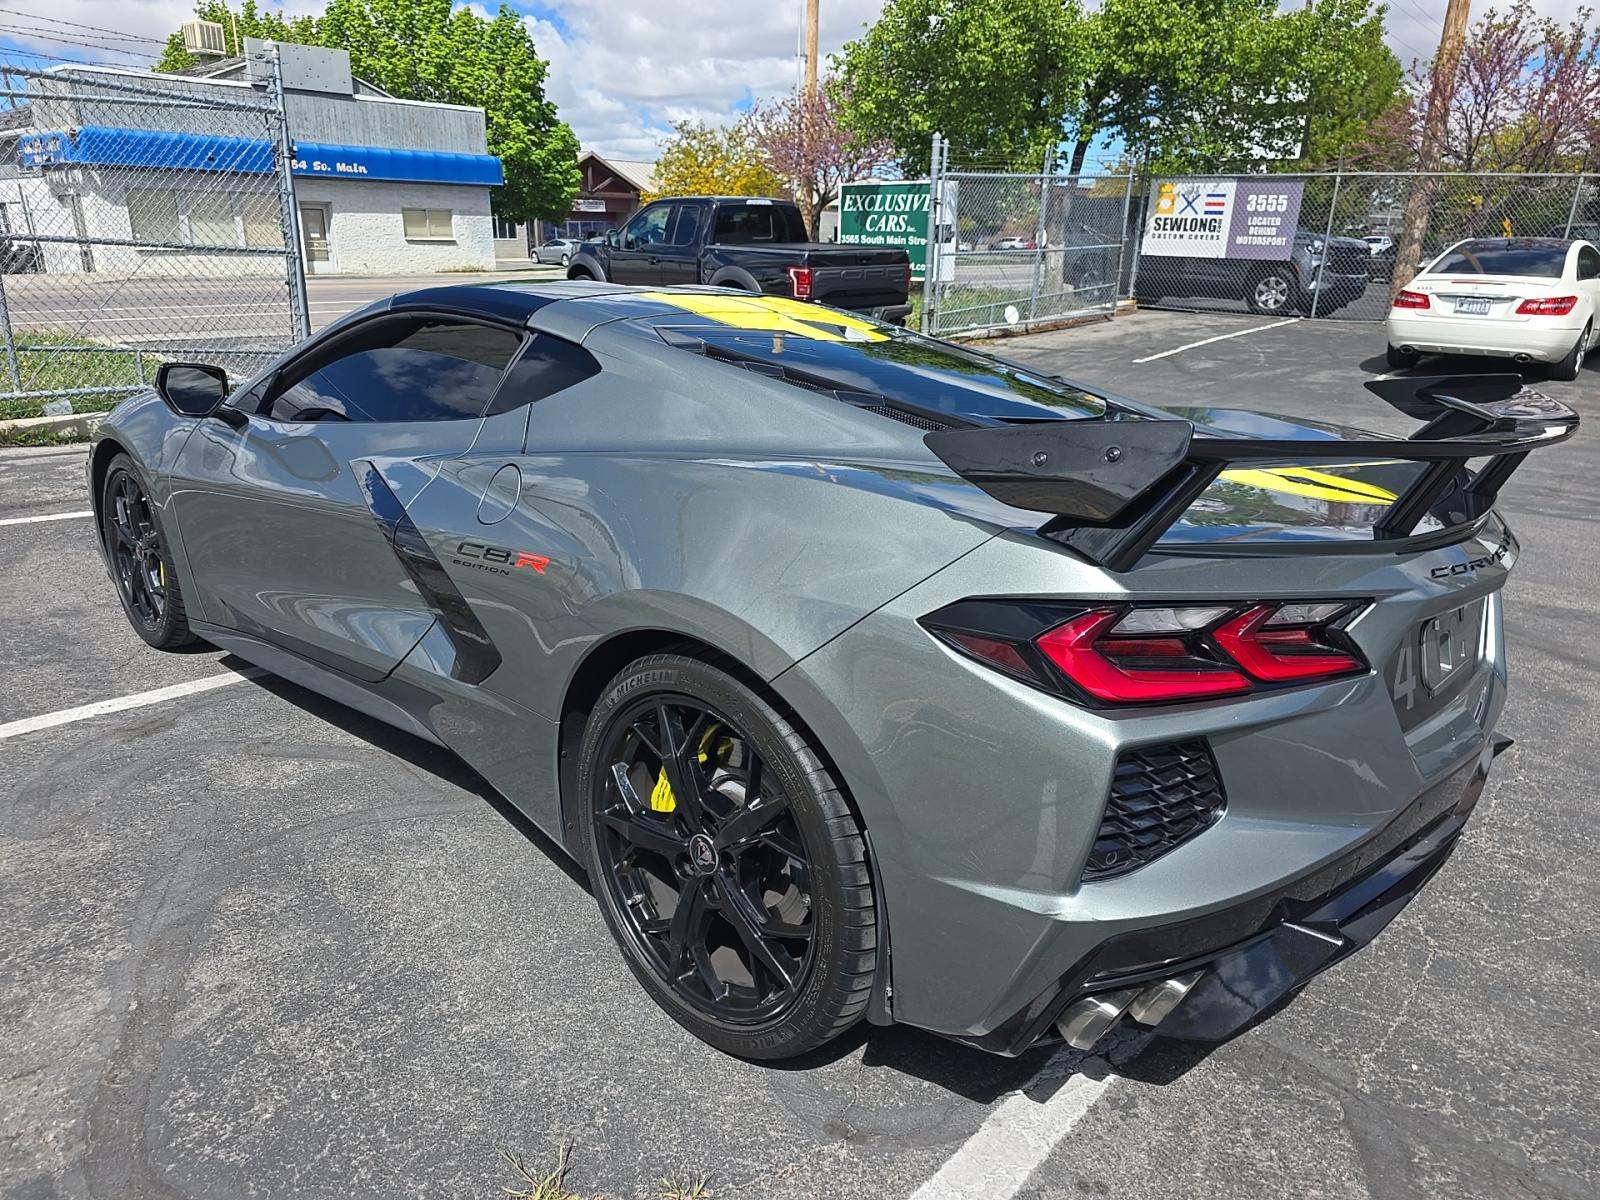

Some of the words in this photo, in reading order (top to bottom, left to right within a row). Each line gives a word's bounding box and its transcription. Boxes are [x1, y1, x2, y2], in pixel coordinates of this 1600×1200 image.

[312, 160, 331, 171] So.
[336, 162, 368, 174] Main
[1246, 194, 1288, 212] 3555
[865, 214, 908, 232] CARS
[1153, 217, 1217, 232] SEWLONG
[1247, 216, 1281, 226] LOCATED
[861, 234, 885, 245] South
[886, 235, 907, 245] Main
[908, 235, 928, 246] Stre
[1236, 235, 1287, 246] MOTORSPORT
[452, 559, 510, 576] EDITION
[615, 670, 674, 700] MICHELIN
